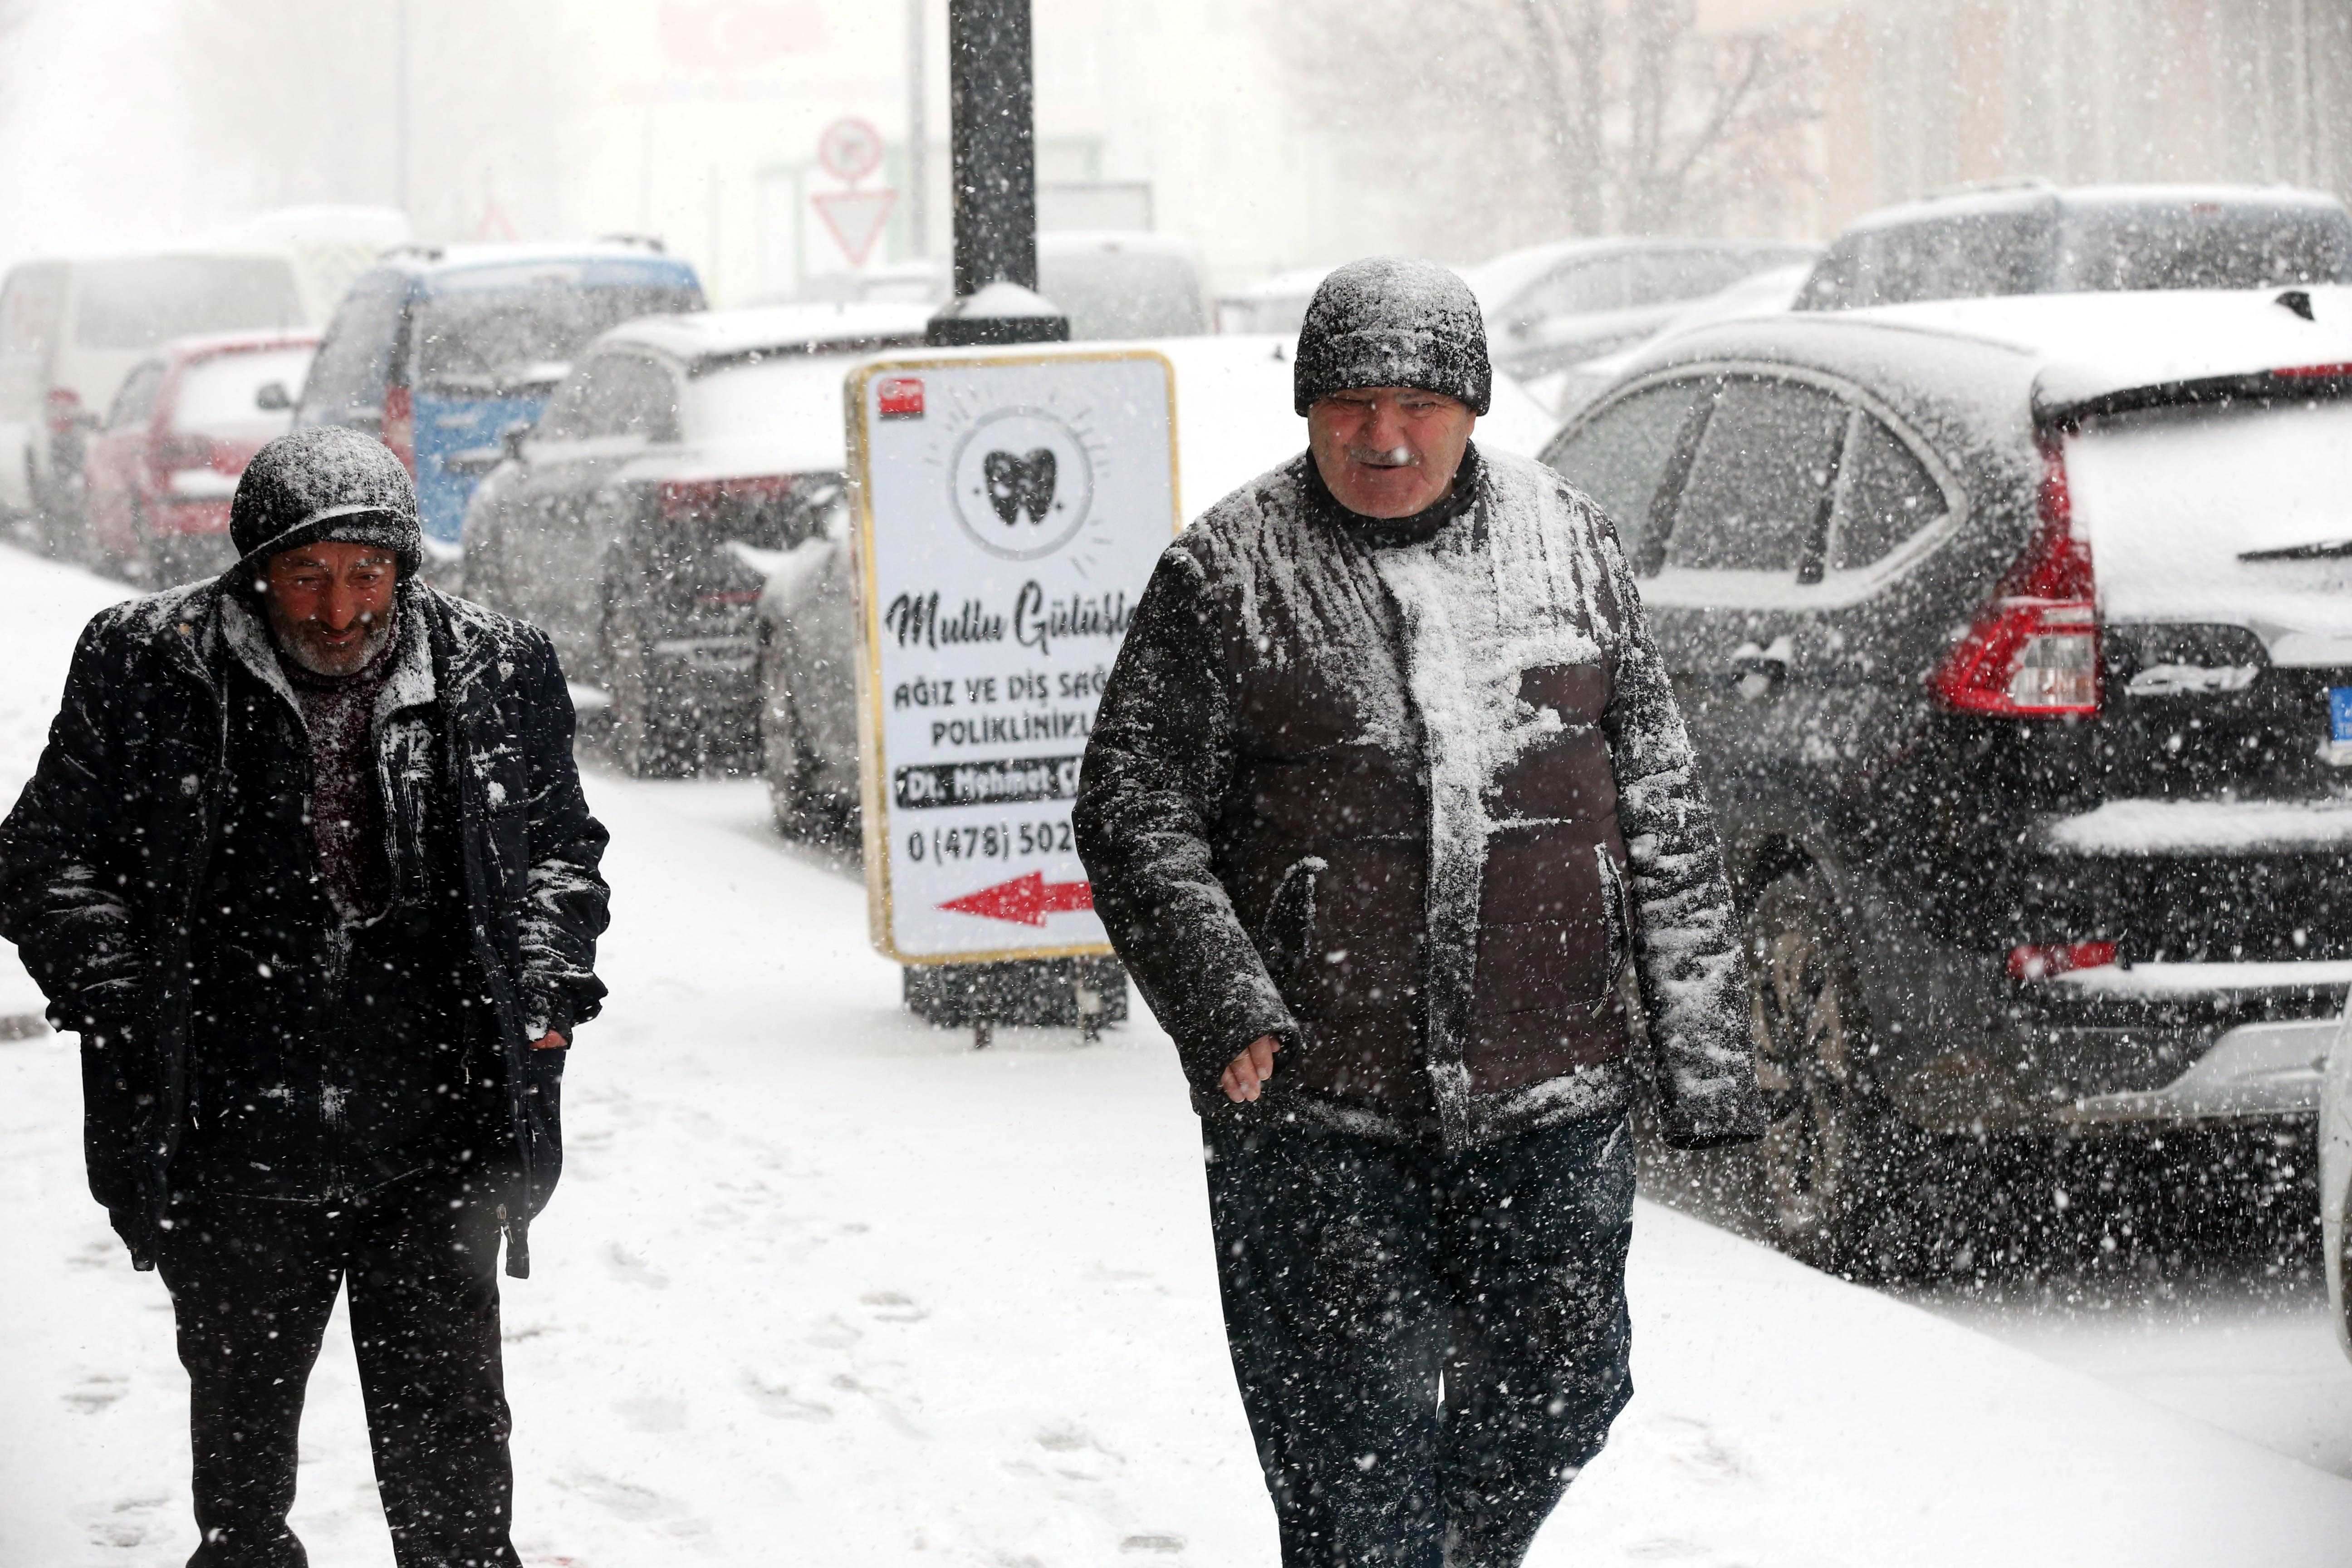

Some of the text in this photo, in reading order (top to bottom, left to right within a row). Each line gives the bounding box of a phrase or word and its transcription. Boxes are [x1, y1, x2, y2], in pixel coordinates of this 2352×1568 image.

[894, 675, 954, 710] AĞIZ
[965, 677, 996, 703] VE
[1008, 667, 1047, 706] DİŞ
[933, 707, 1094, 745] POLİKLİNİKL
[954, 765, 1050, 798] Mehmet
[909, 821, 1072, 865] 0 (478) 502
